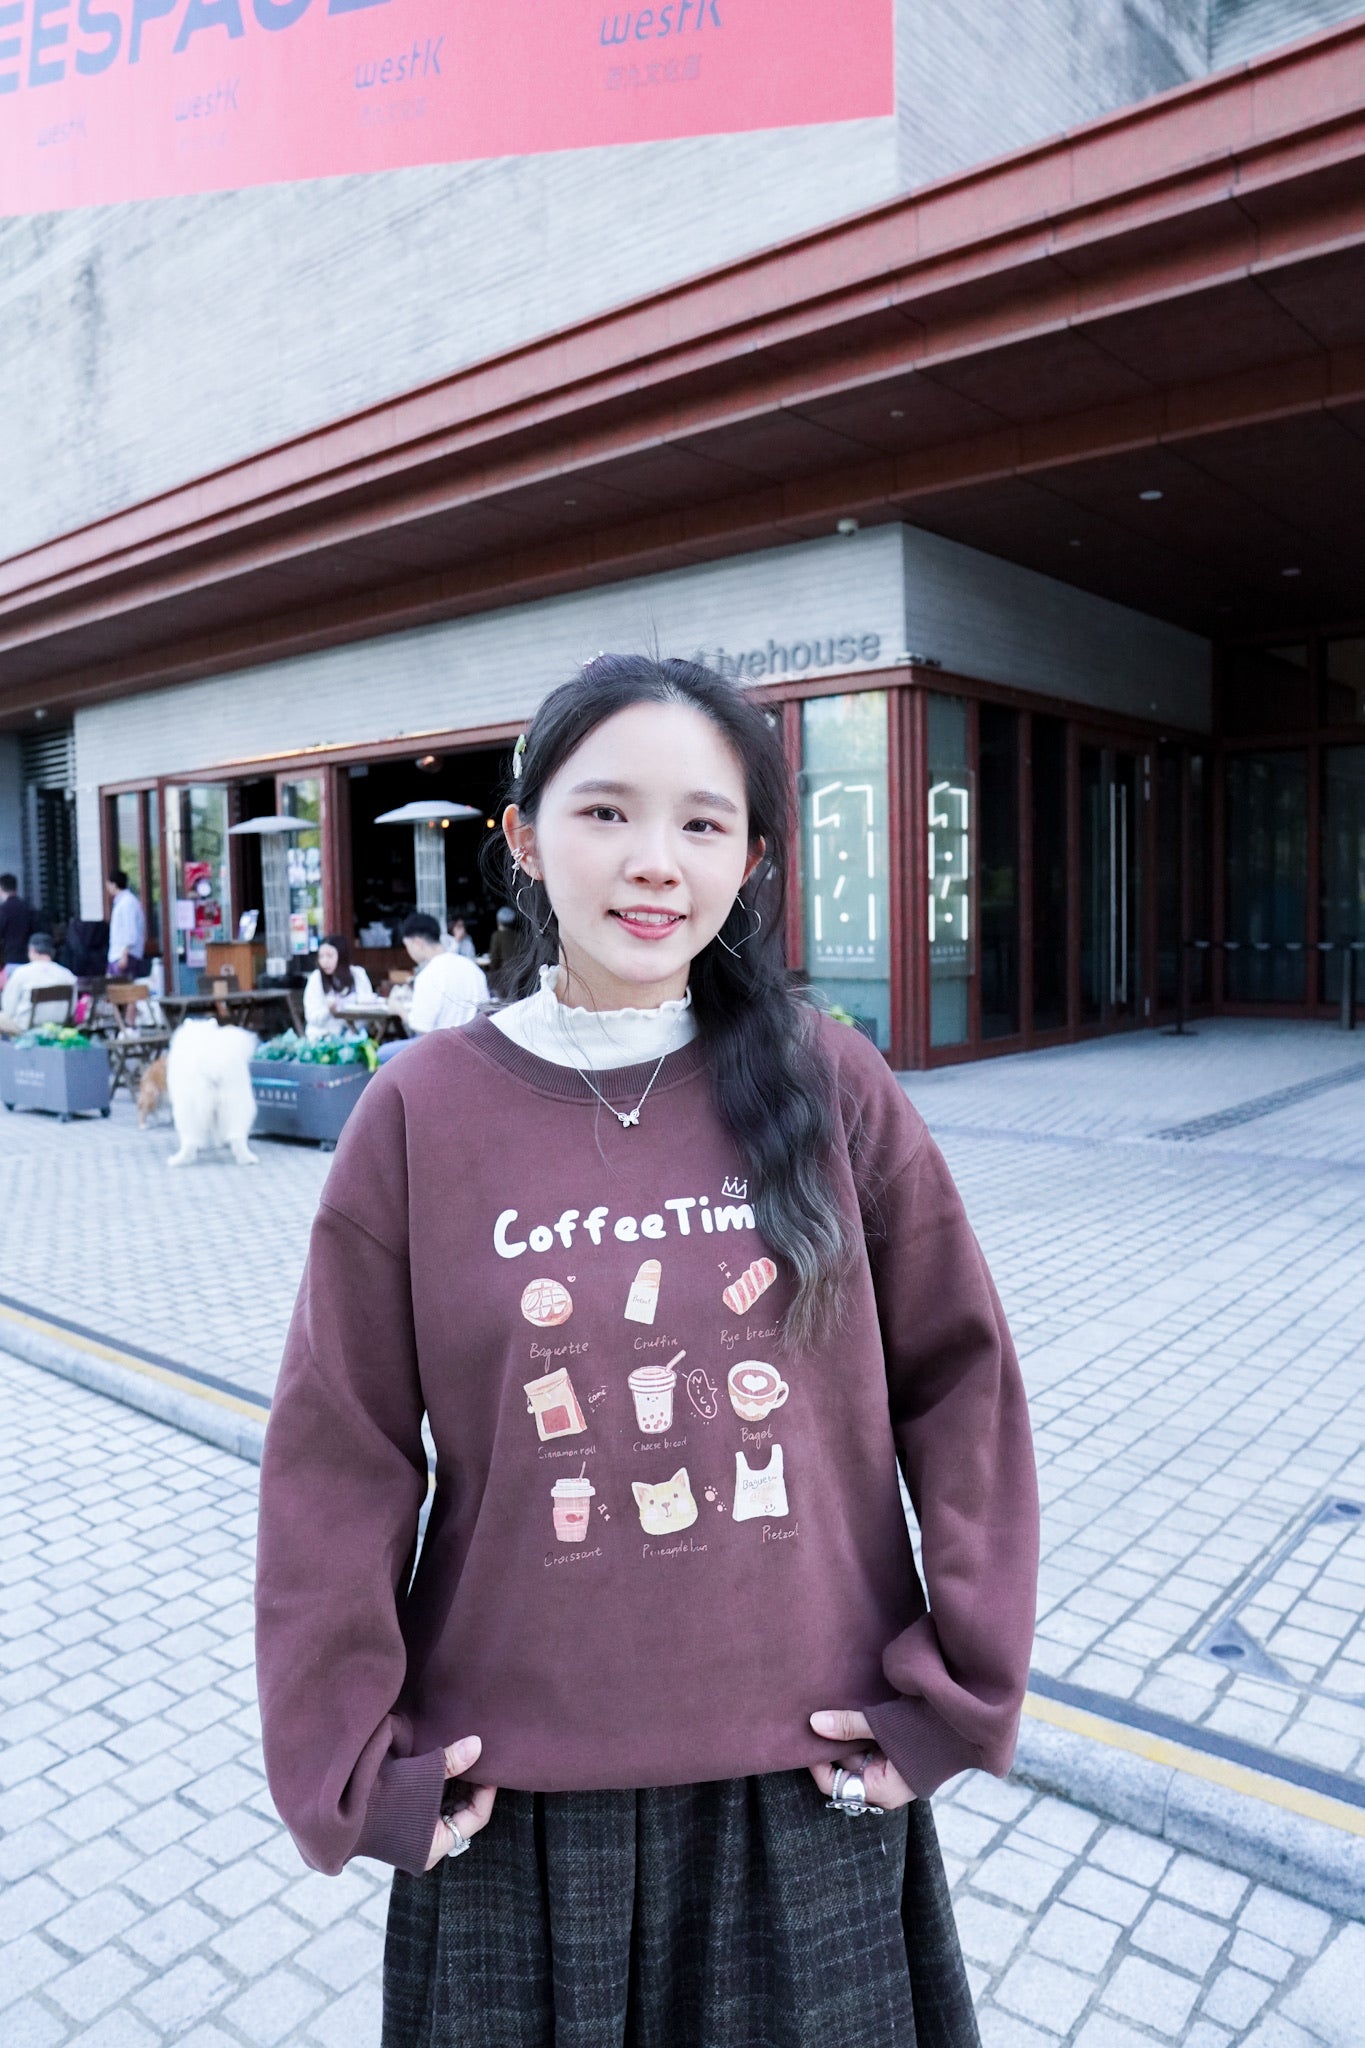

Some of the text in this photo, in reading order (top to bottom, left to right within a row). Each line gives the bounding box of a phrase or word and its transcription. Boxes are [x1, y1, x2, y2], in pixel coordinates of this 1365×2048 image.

[354, 35, 444, 89] westK
[720, 1329, 741, 1350] Rye
[529, 1341, 590, 1374] Baguette
